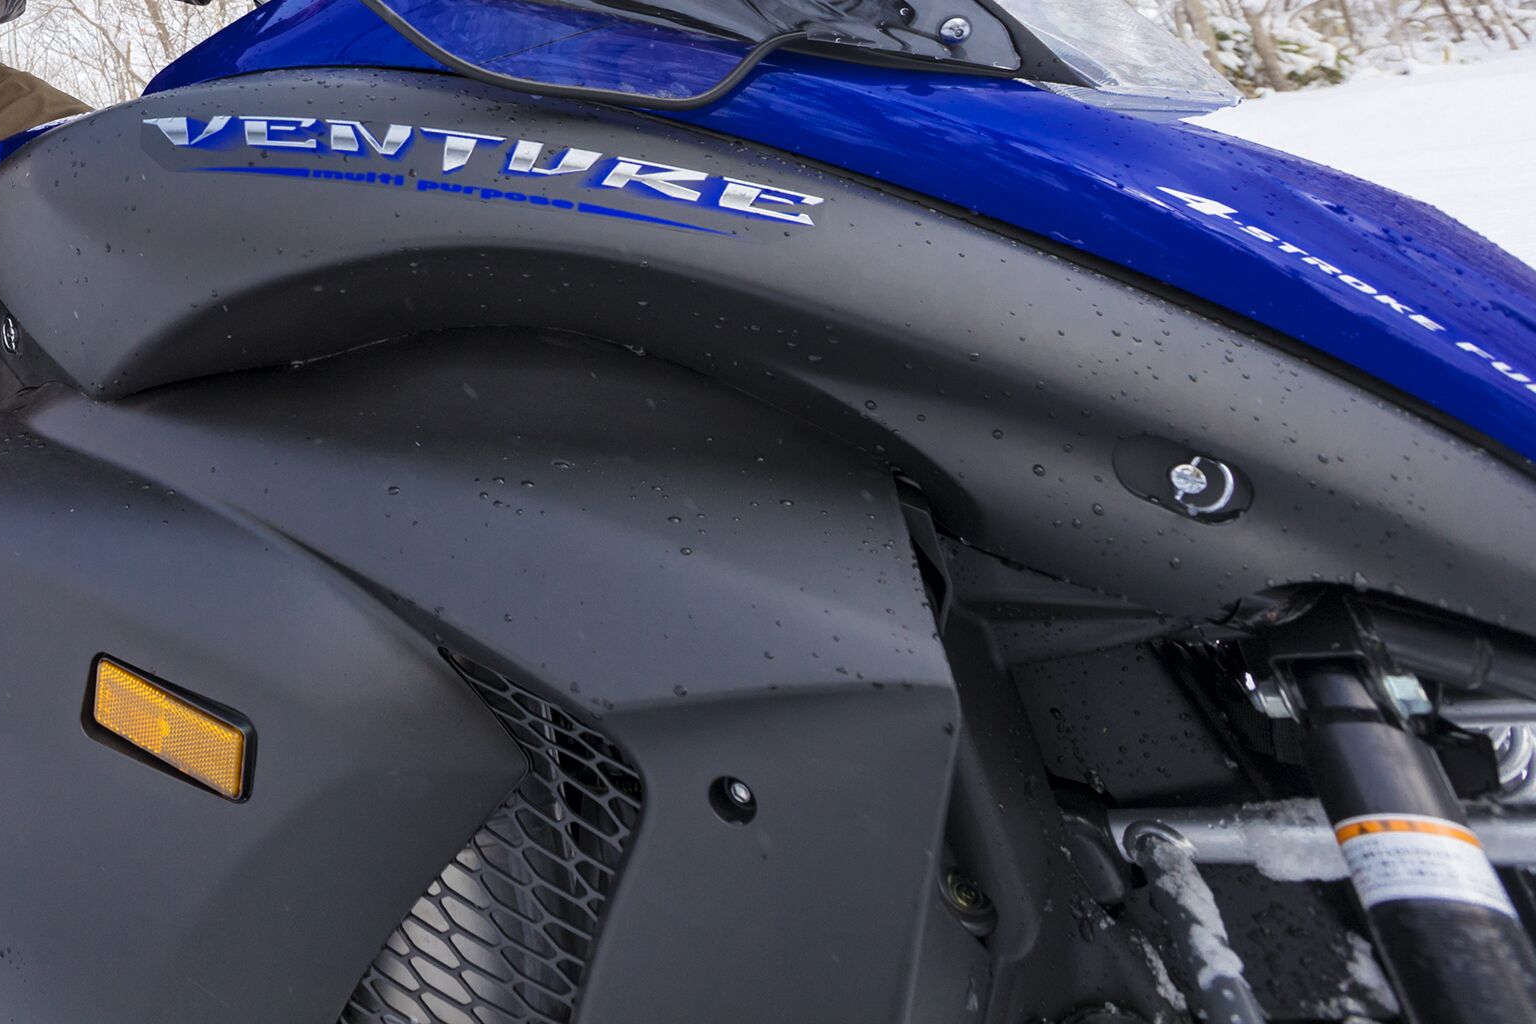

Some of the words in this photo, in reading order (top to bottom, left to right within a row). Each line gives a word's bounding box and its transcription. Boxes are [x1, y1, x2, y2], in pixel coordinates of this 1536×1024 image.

[143, 115, 824, 227] VENTURE
[312, 168, 405, 186] multi
[417, 179, 575, 210] purpose
